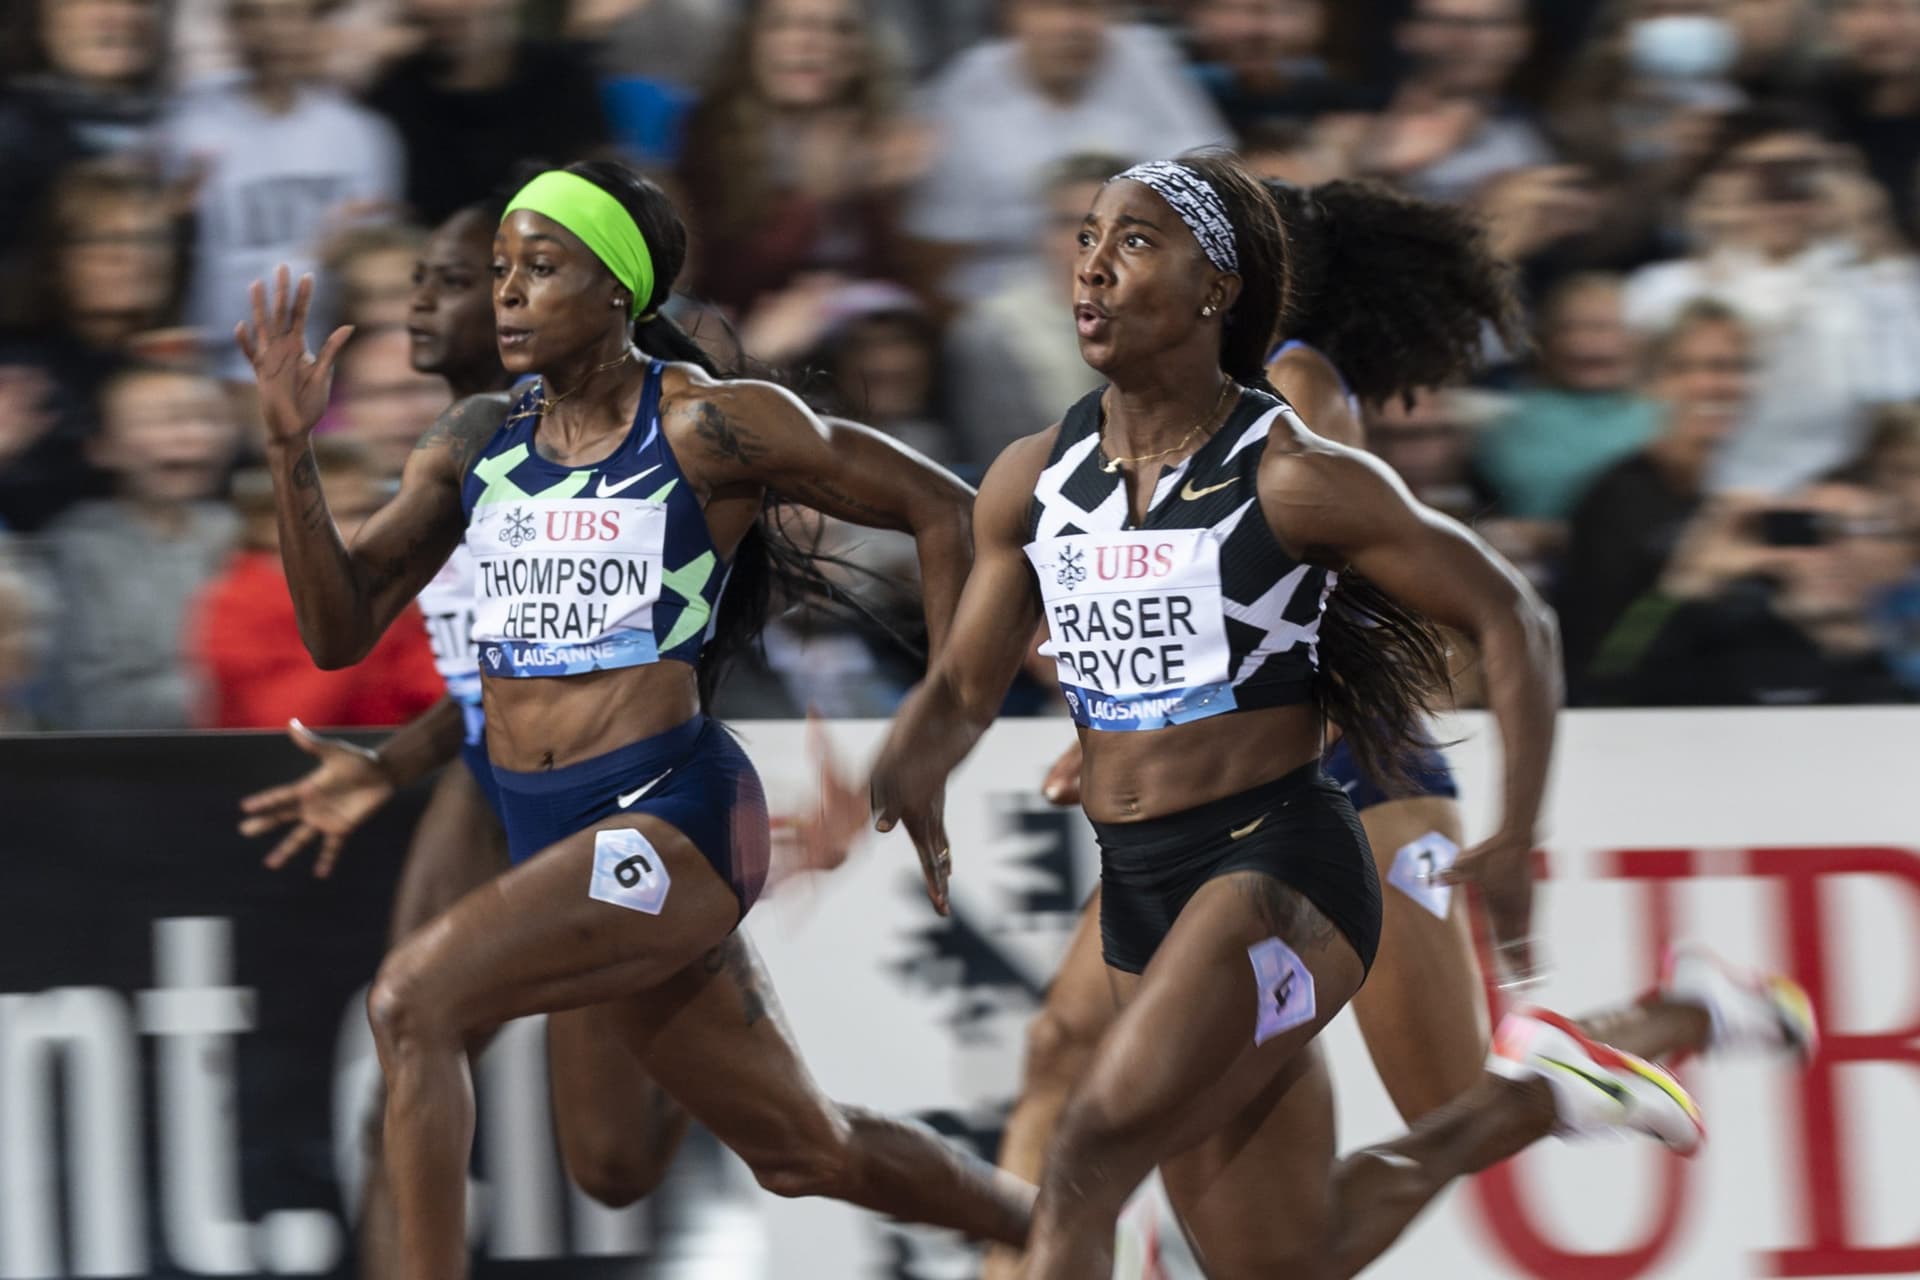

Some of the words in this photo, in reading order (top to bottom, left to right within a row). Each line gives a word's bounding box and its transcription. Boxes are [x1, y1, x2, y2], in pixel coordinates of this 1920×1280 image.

[545, 509, 620, 542] UBS
[480, 558, 648, 598] THOMPSON
[1096, 543, 1175, 581] UBS
[503, 602, 607, 640] HERAH
[512, 643, 616, 667] LAUSANNE
[614, 854, 652, 889] 6
